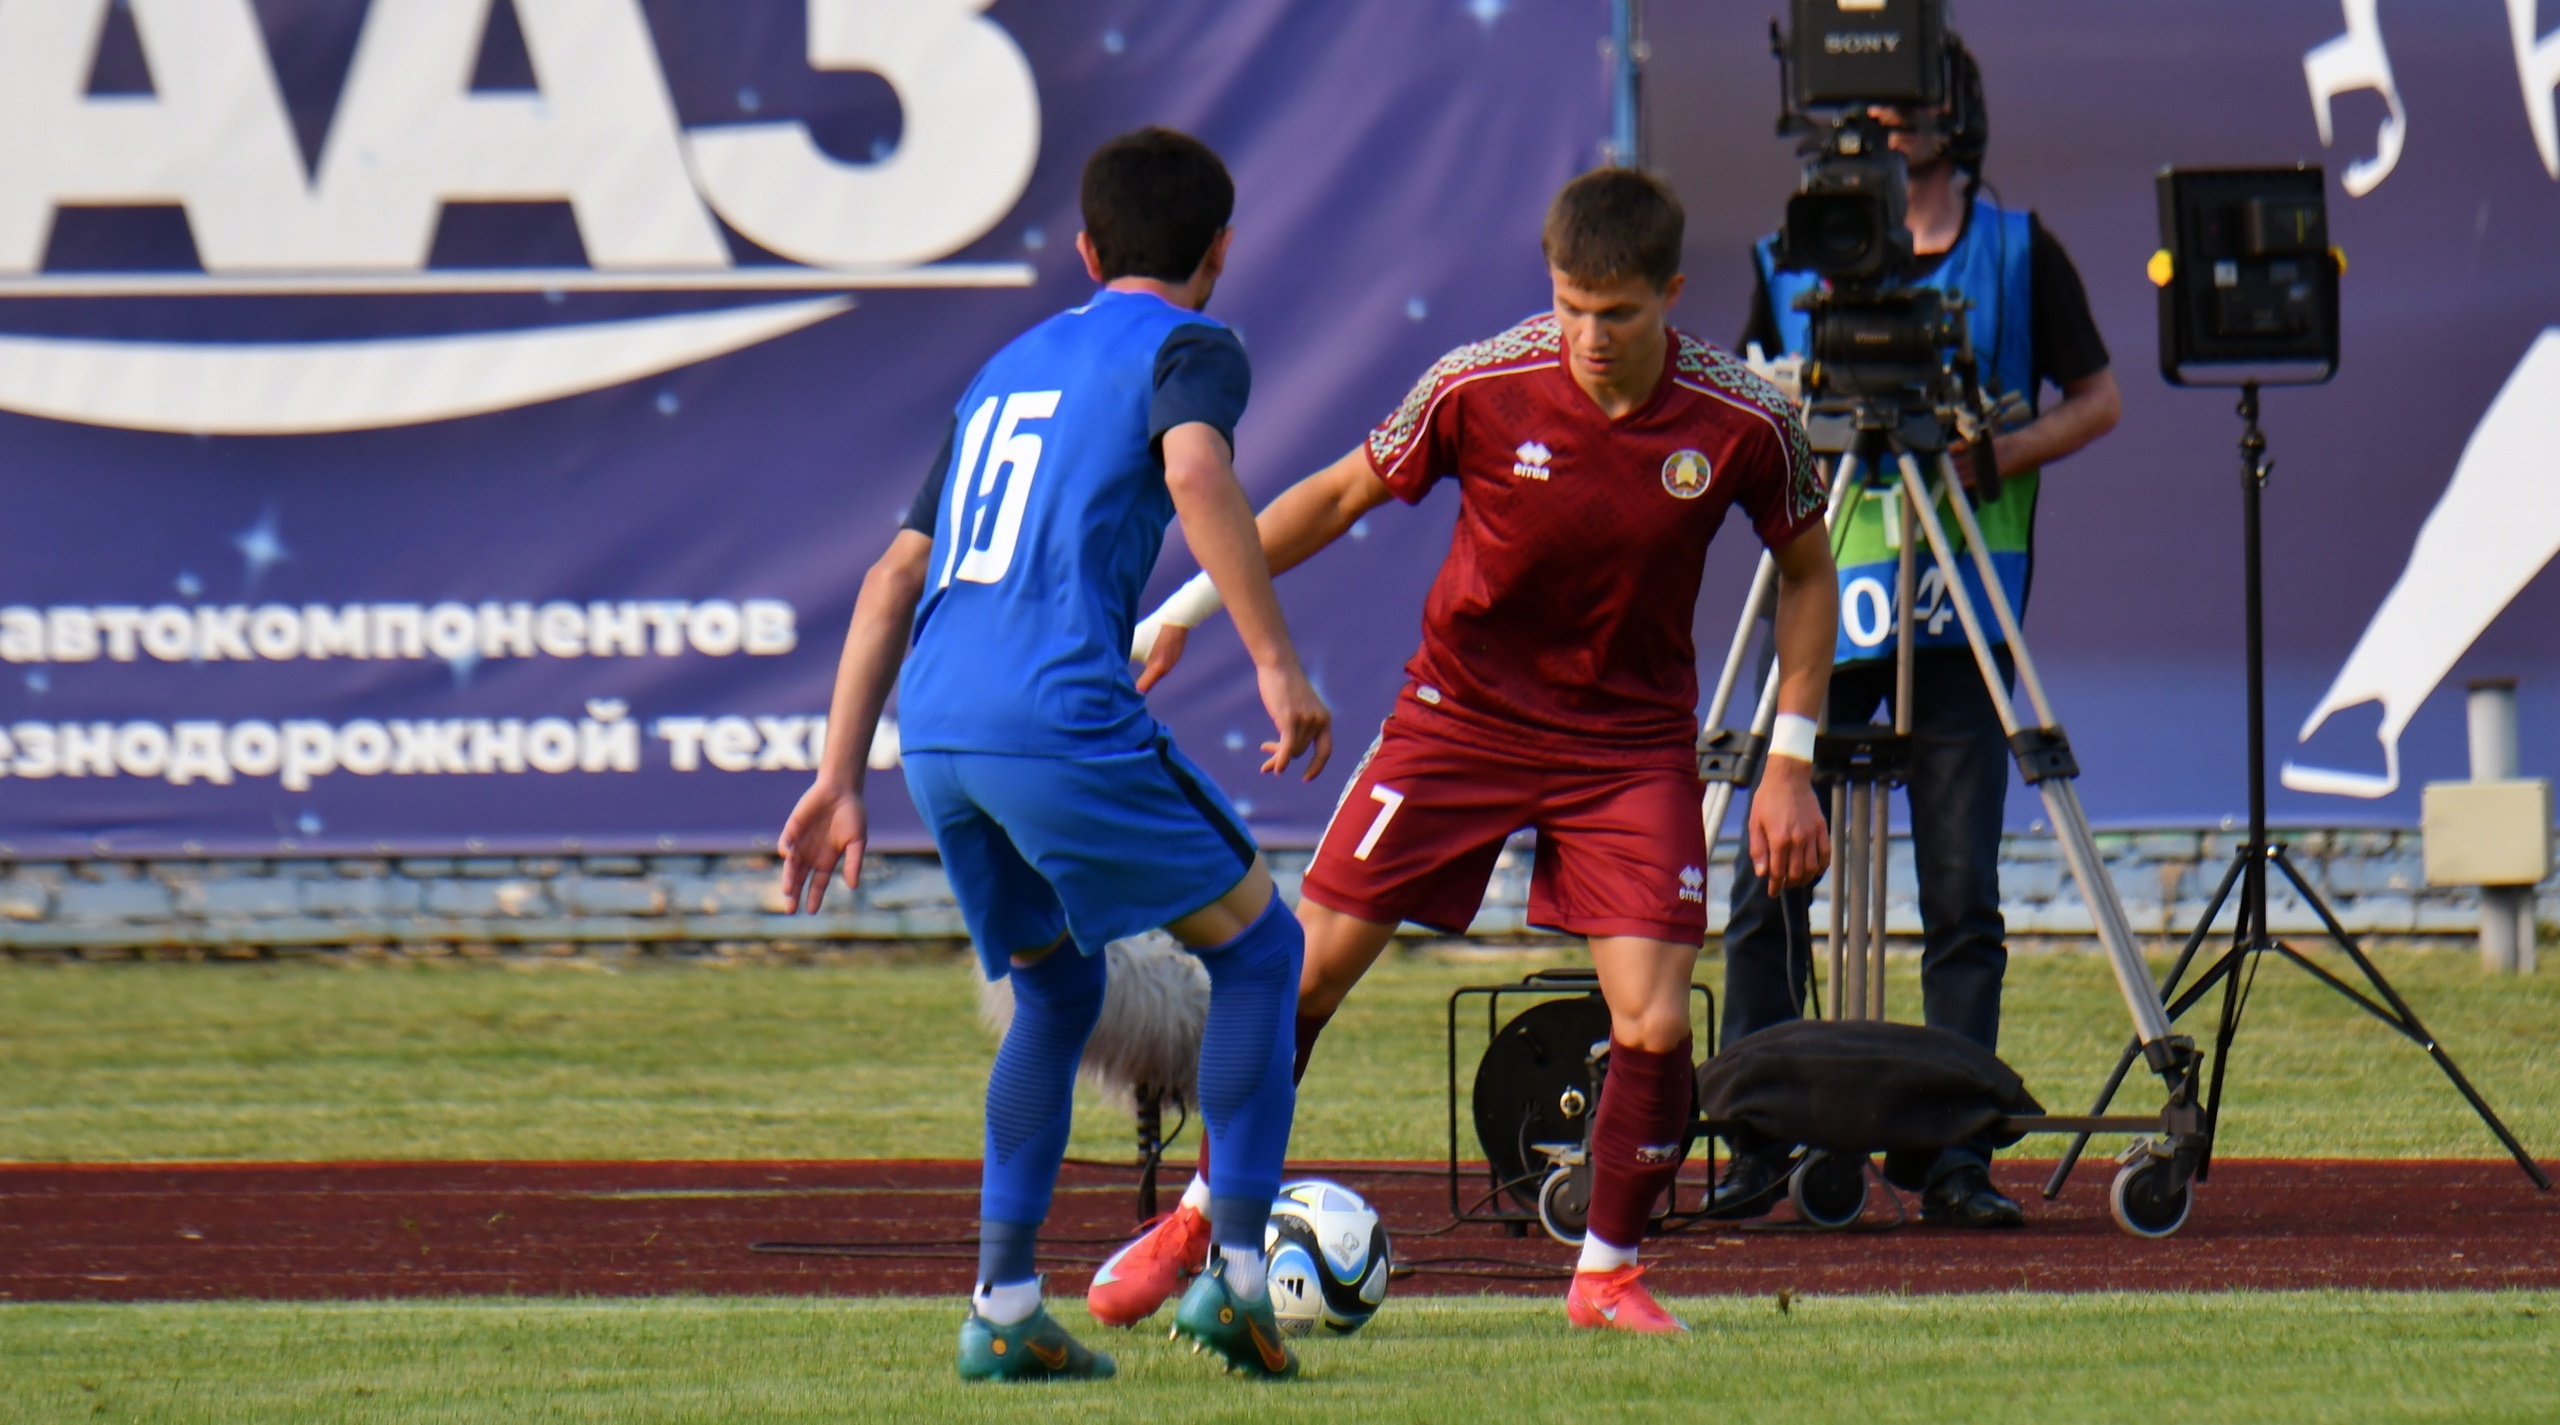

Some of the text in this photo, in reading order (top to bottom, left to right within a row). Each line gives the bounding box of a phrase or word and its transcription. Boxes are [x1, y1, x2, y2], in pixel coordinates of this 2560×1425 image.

[1824, 32, 1900, 53] SONY
[938, 390, 1062, 588] 15
[0, 600, 798, 663] автокомпонентов
[0, 698, 640, 791] знодорожной
[1353, 783, 1405, 861] 7
